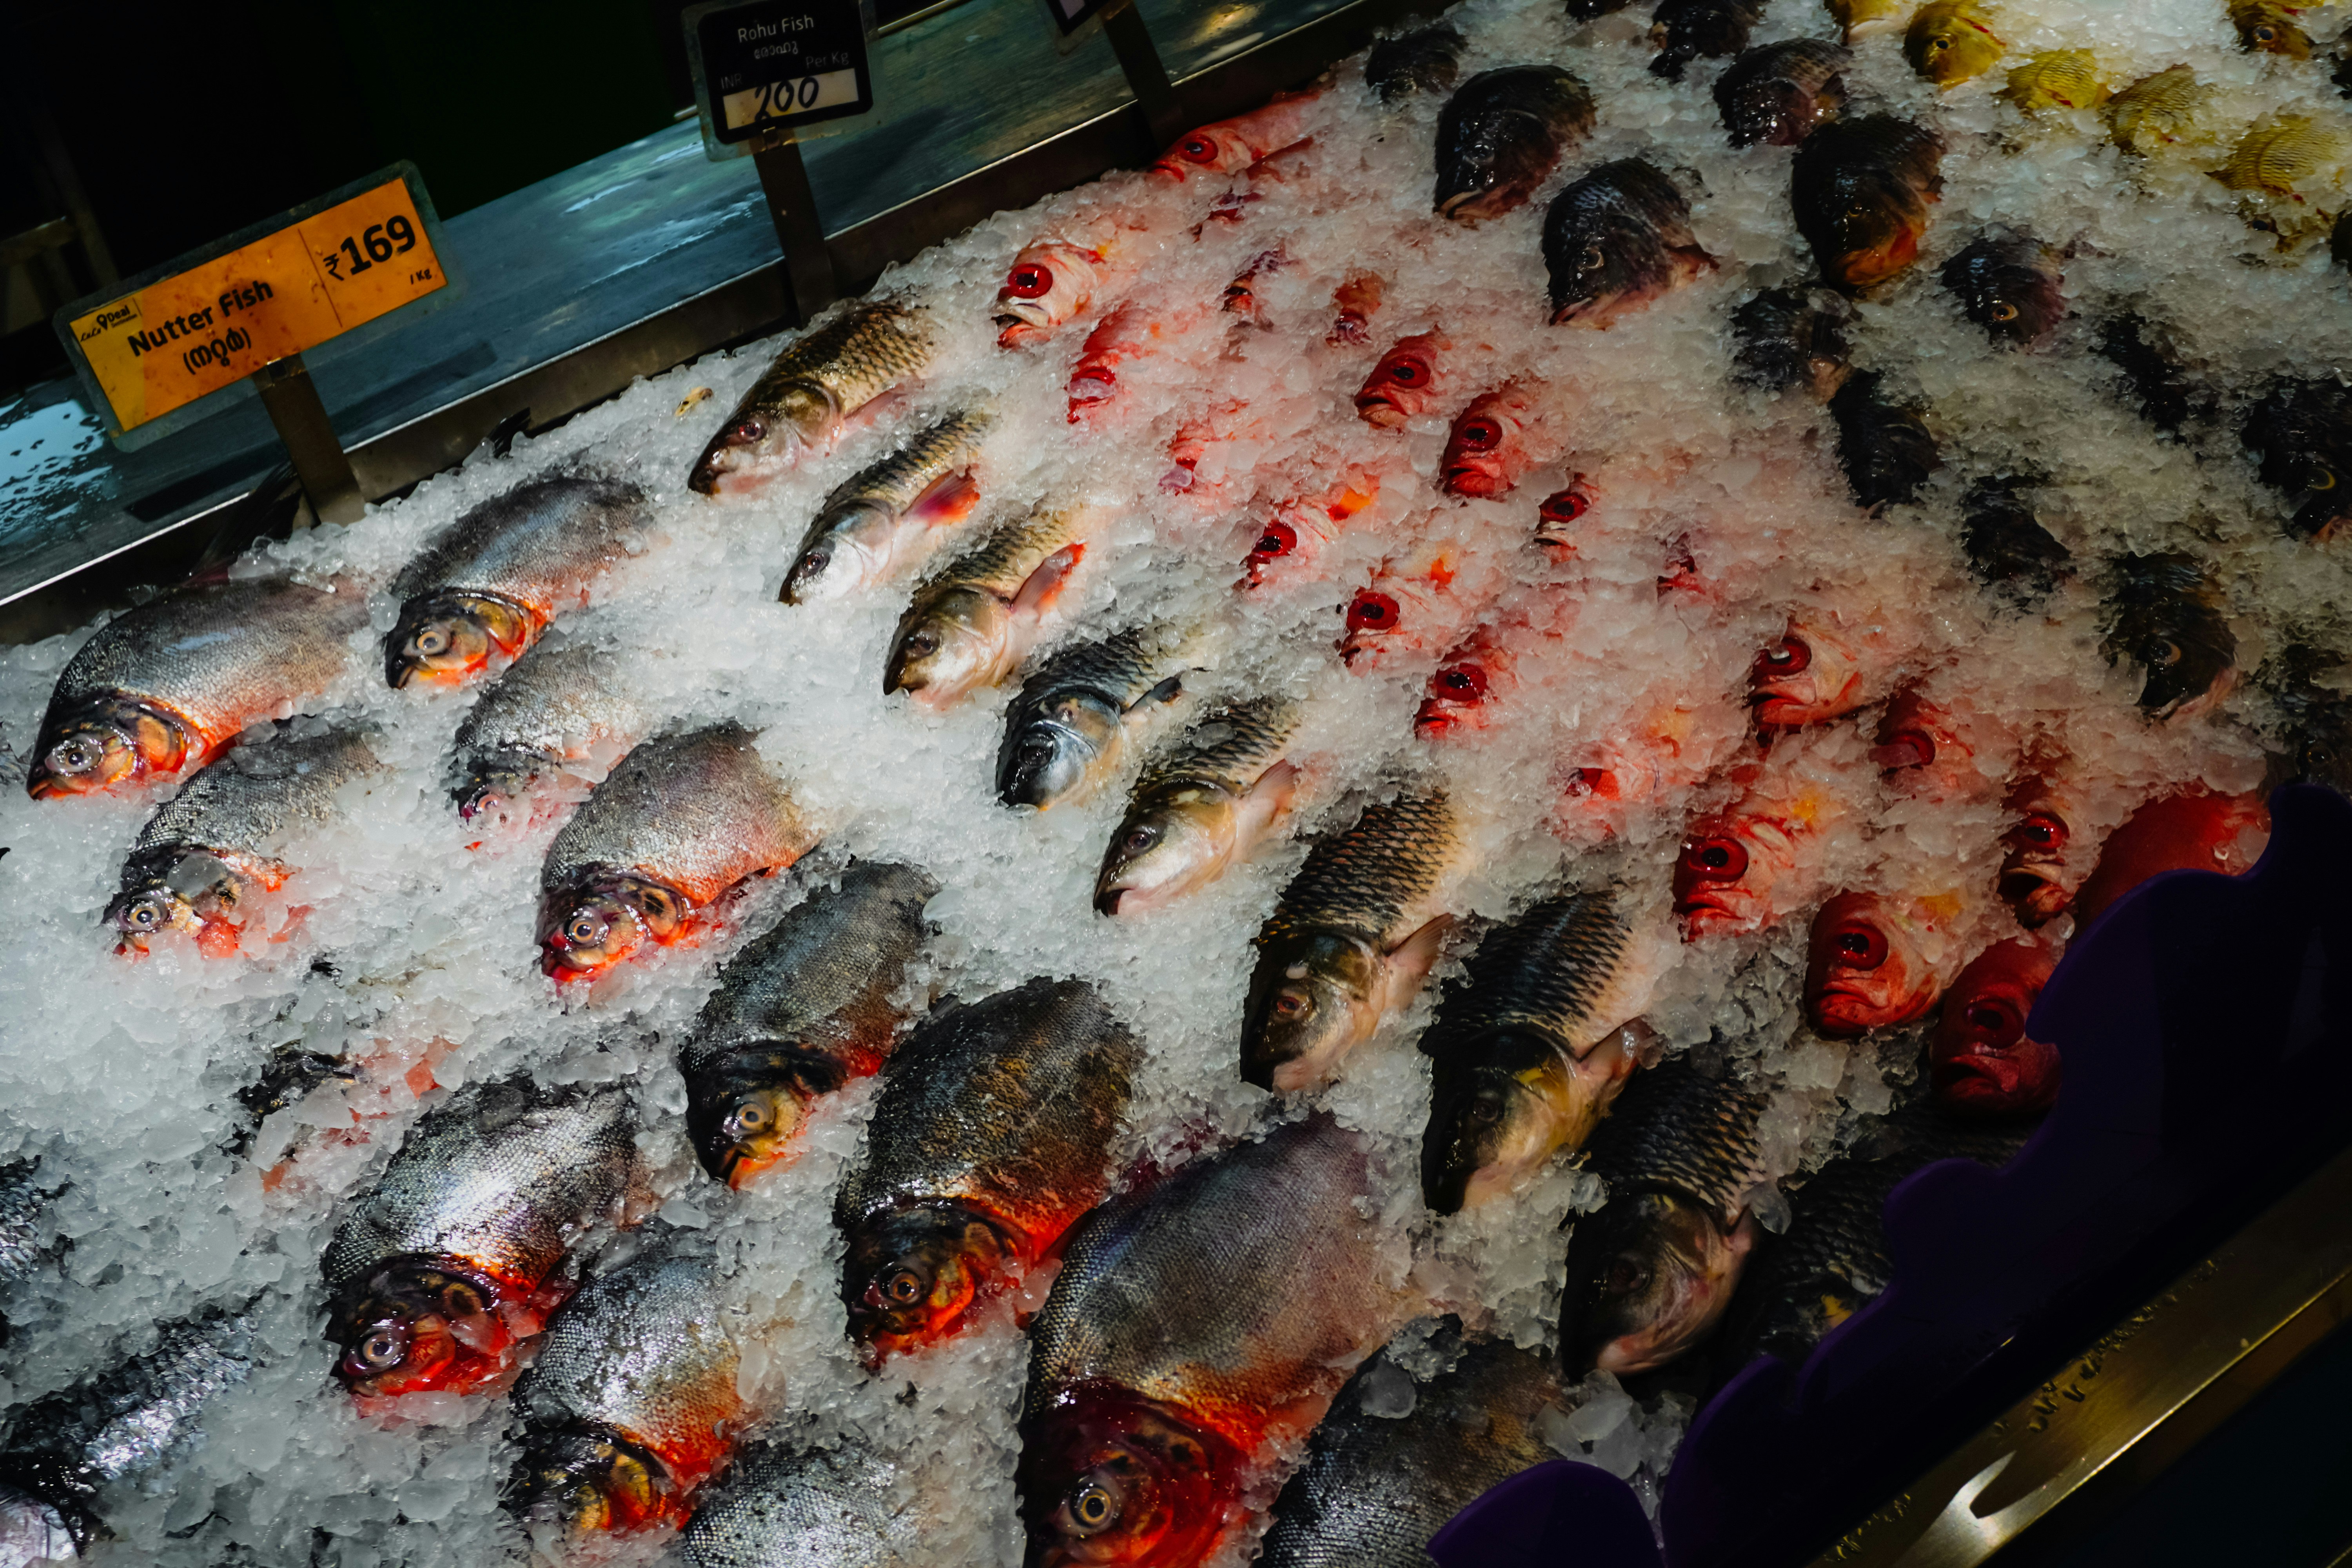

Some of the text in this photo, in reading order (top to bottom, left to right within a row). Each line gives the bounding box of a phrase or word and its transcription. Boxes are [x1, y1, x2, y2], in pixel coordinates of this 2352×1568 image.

[738, 15, 814, 43] Rohu Fish
[806, 52, 849, 68] Per Kg
[721, 73, 742, 89] INR
[755, 76, 819, 122] 200
[107, 305, 130, 322] Deal
[127, 281, 273, 356] Nutter Fish
